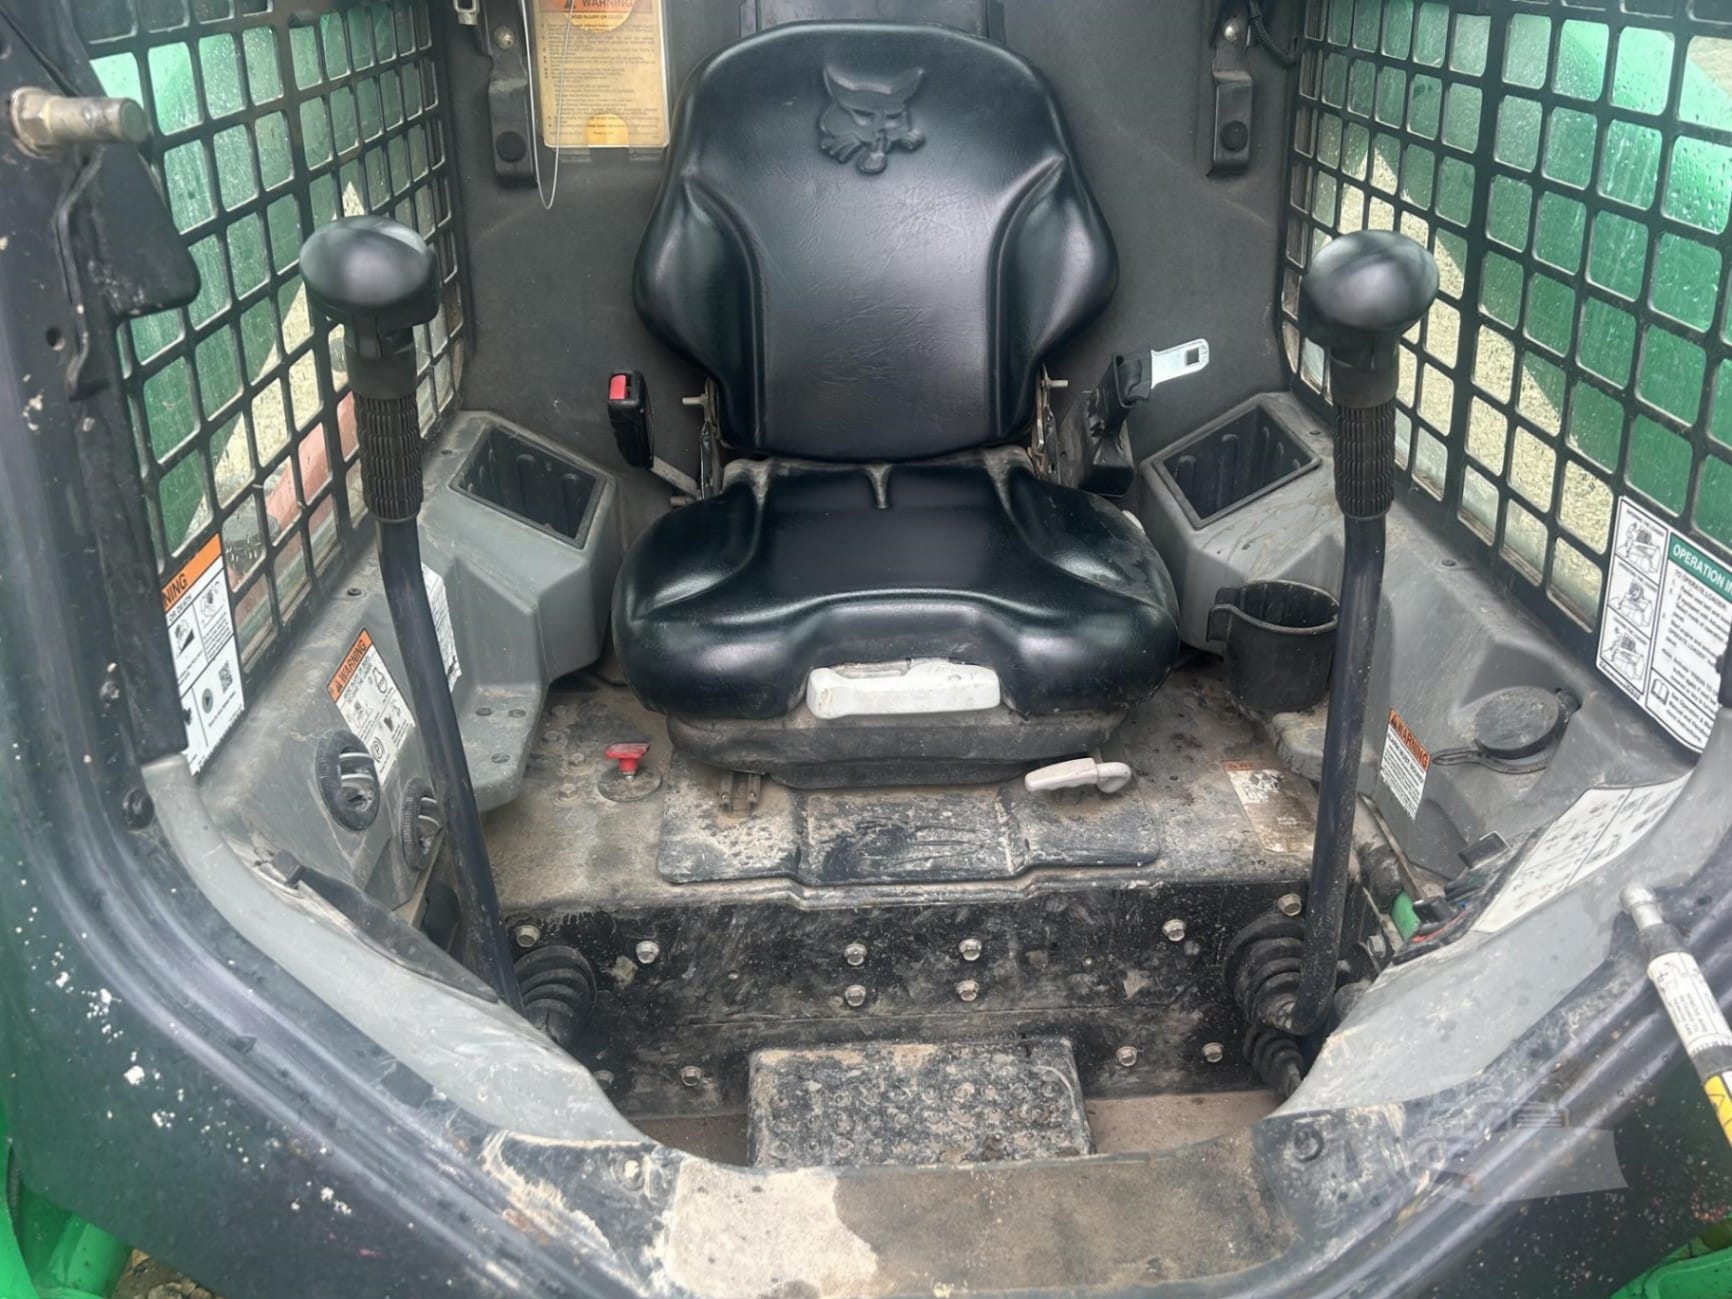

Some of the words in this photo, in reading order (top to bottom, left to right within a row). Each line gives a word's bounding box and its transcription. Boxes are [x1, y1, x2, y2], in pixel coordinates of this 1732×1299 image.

[582, 0, 632, 8] WARNING
[1673, 544, 1725, 587] OPERATION
[338, 639, 366, 684] WARNING
[1397, 720, 1428, 768] WARNING
